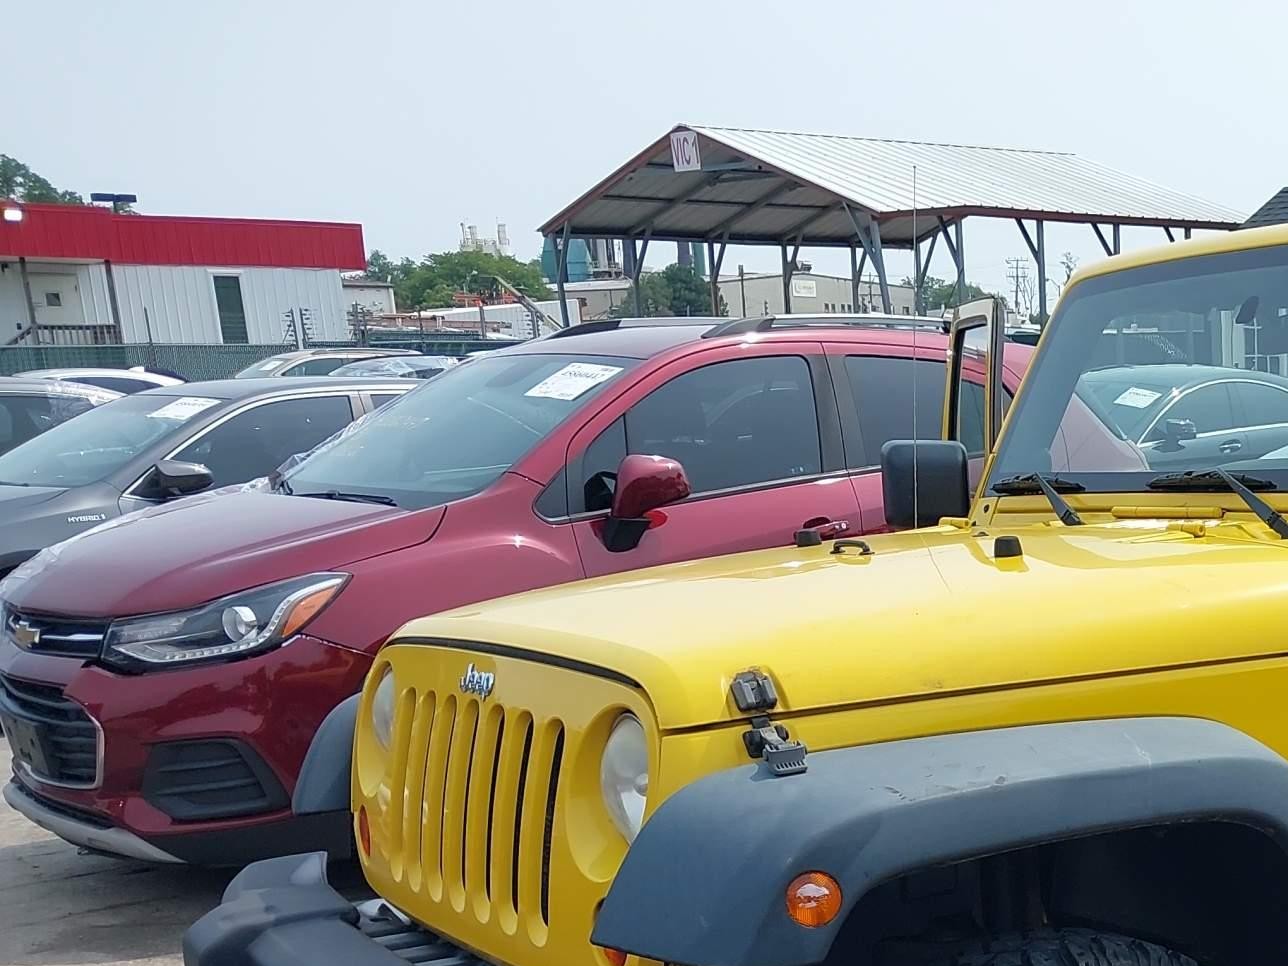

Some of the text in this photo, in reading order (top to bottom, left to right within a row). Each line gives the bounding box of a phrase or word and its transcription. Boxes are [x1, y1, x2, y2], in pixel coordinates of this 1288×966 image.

[671, 135, 700, 166] VIC 1
[460, 663, 495, 700] Jeep
